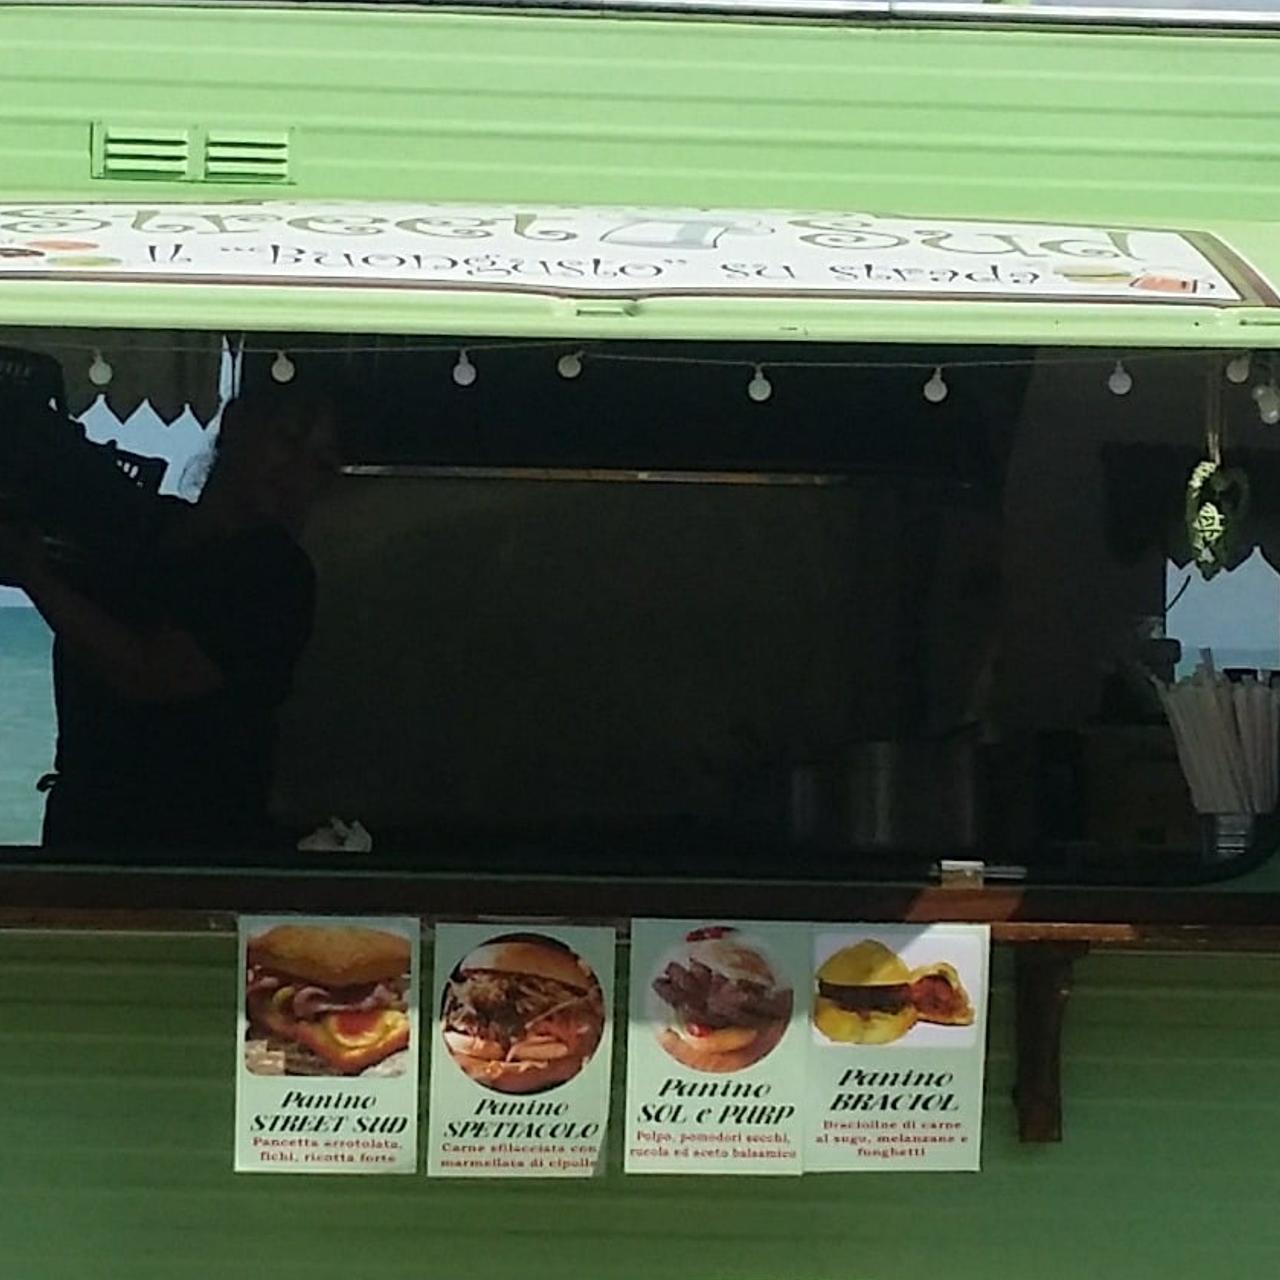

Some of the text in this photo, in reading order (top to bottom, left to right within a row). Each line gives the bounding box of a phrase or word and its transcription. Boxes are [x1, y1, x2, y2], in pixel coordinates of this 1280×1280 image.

[0, 208, 1145, 261] Street Sud
[720, 261, 797, 280] su
[828, 263, 1041, 284] strada
[658, 1078, 772, 1097] Panino
[838, 1069, 954, 1087] Panino
[281, 1090, 377, 1109] Panino
[474, 1098, 569, 1116] Panino
[829, 1093, 960, 1111] BRACIOL
[250, 1114, 409, 1133] STREET SUD
[637, 1104, 796, 1124] SOL e PURP
[443, 1121, 600, 1139] SPETTACOLO
